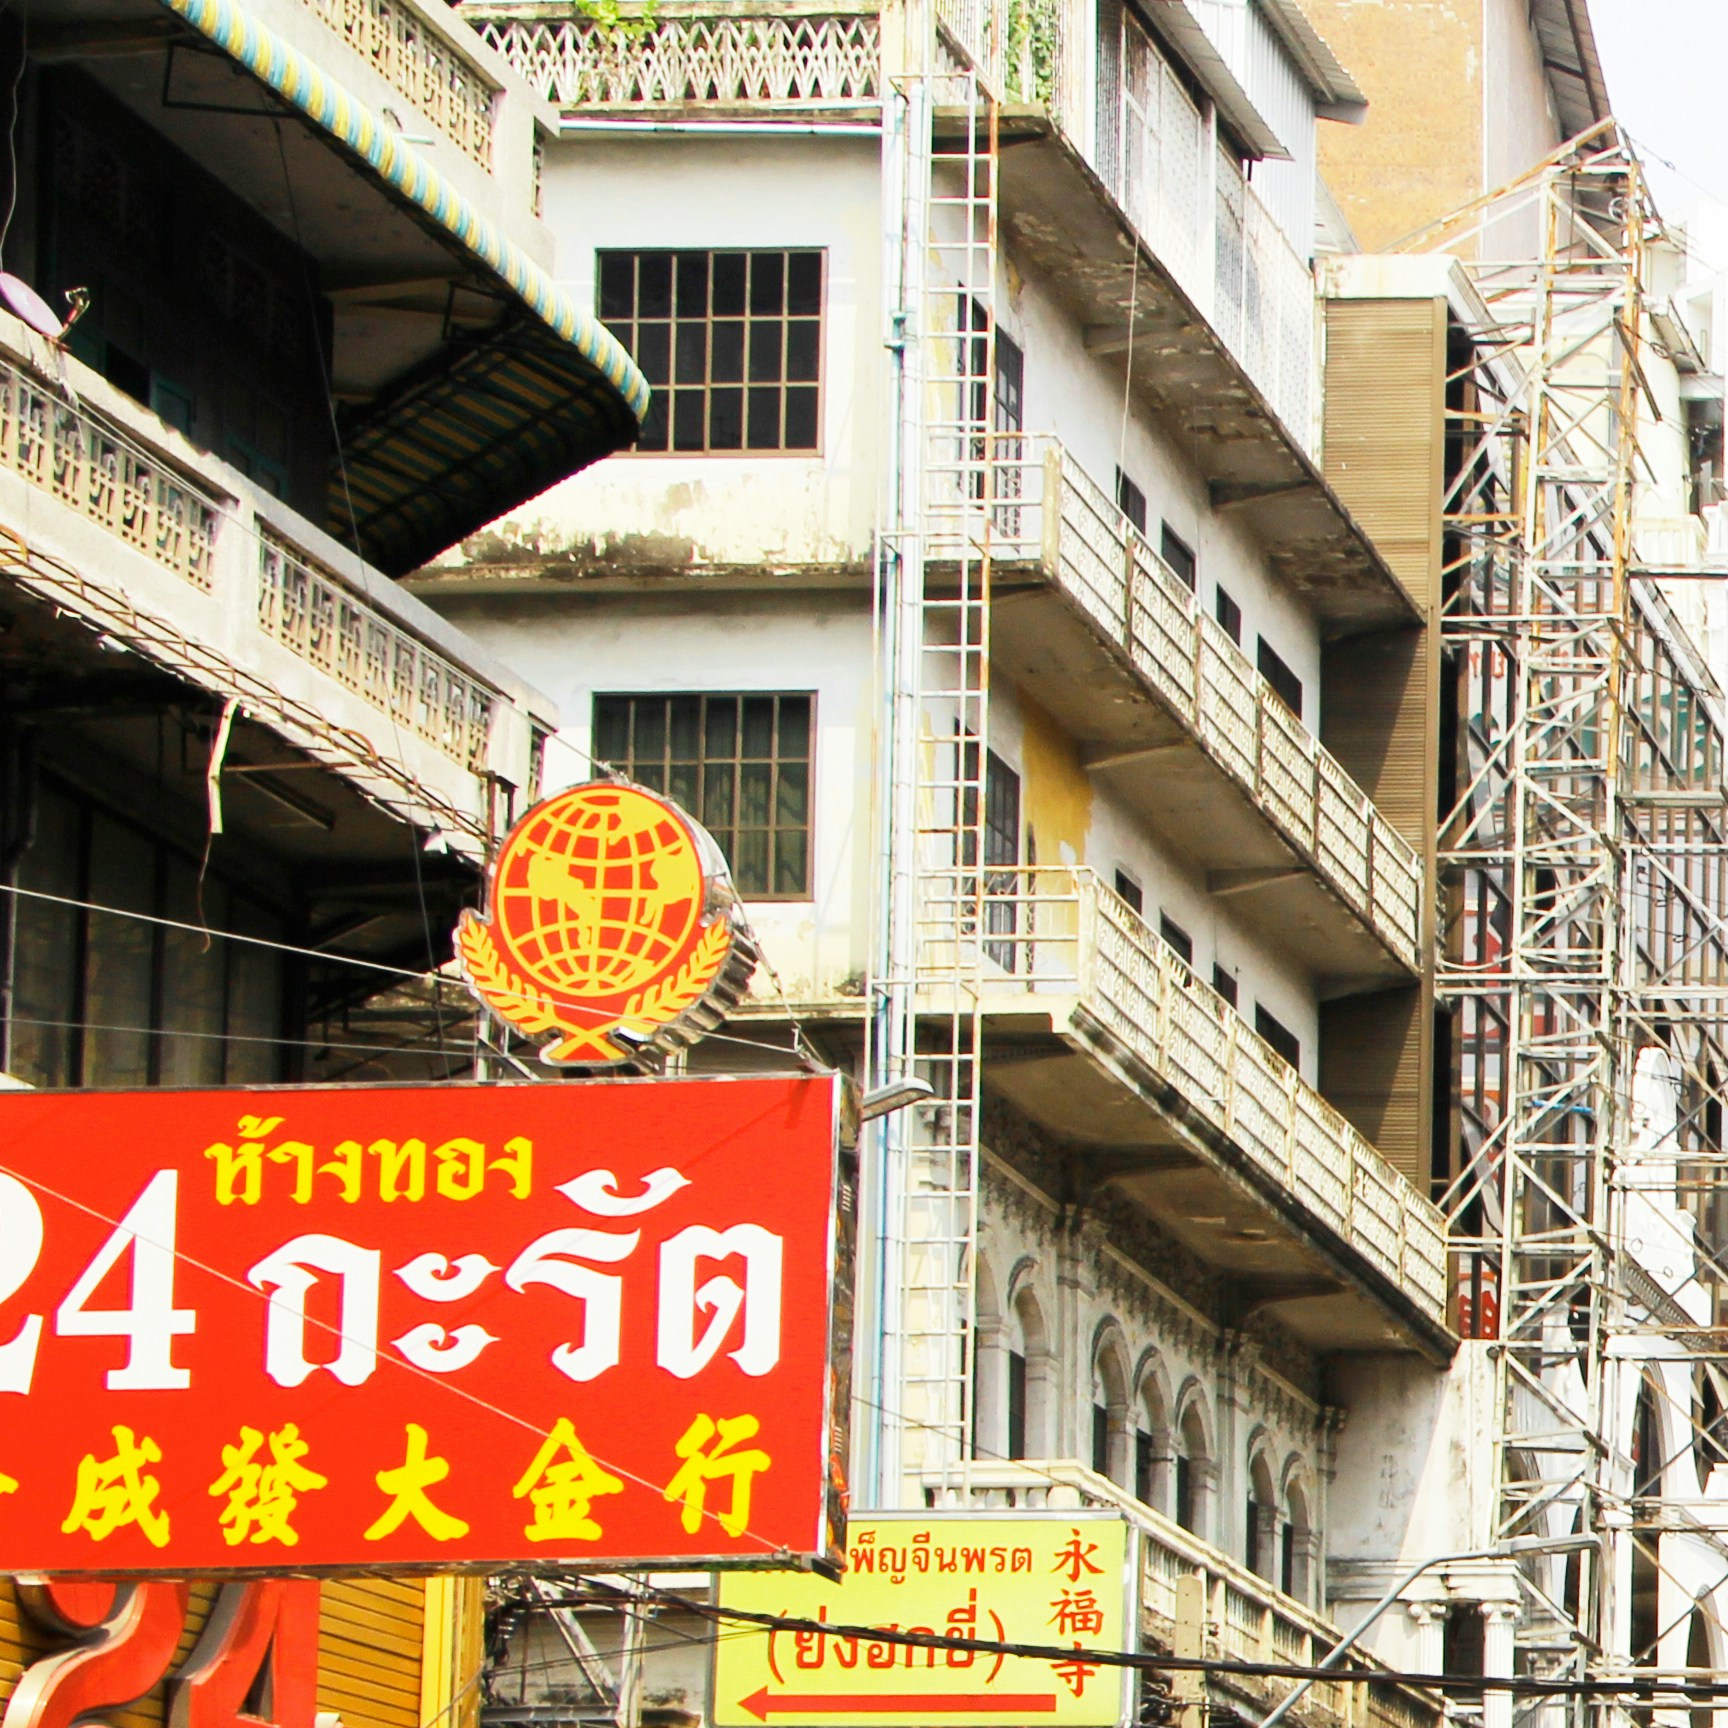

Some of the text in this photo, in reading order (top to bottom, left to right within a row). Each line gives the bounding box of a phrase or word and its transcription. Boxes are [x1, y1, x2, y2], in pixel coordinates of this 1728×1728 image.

[205, 1115, 534, 1206] ห้างทอง
[1047, 1528, 1105, 1698] 永福寺
